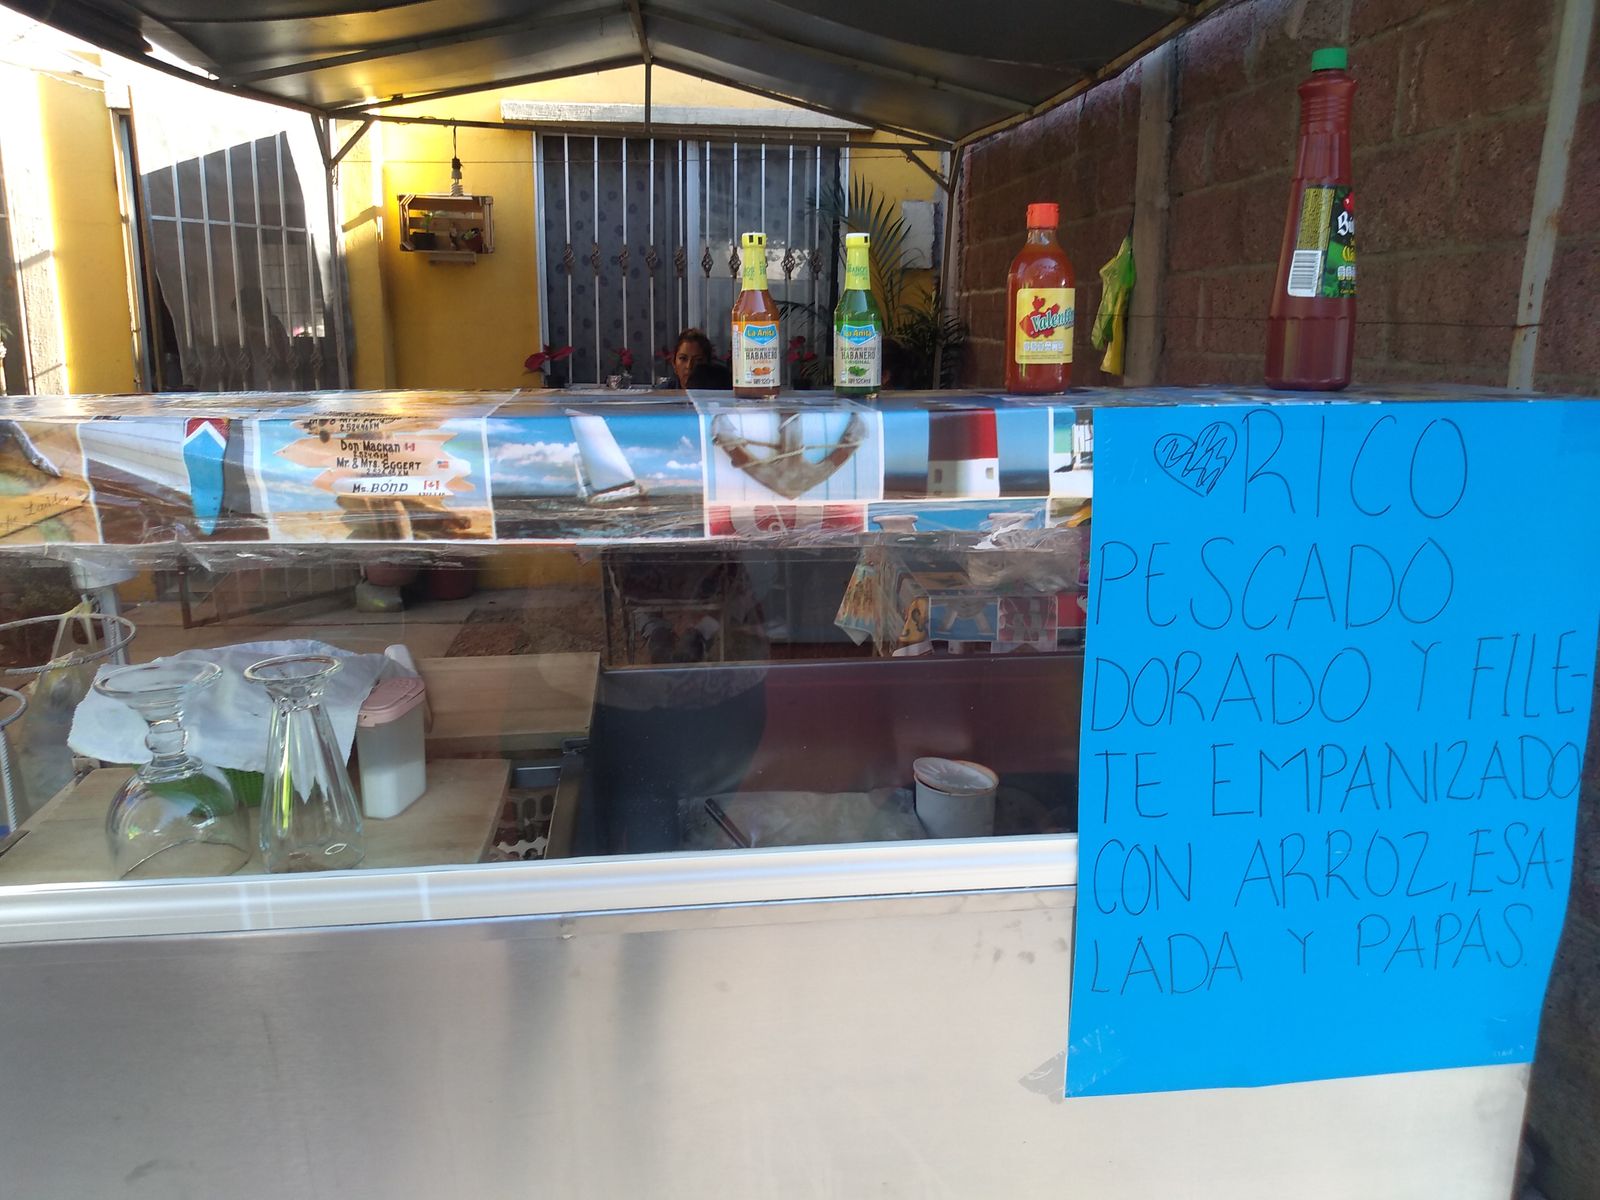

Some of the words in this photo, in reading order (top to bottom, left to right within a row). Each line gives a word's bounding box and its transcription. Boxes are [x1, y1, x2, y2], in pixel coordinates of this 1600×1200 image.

[841, 351, 876, 360] HABANERO
[336, 457, 350, 469] Mr.
[352, 458, 358, 469] &
[361, 459, 380, 469] Mrs.
[341, 440, 359, 452] Don
[1242, 408, 1468, 518] RICO
[1096, 537, 1454, 630] PESCADO
[1091, 646, 1372, 731] DORADO
[1411, 641, 1442, 711] Y
[1468, 630, 1588, 720] FILE-
[1094, 749, 1169, 824] TE
[1211, 735, 1581, 818] EMPANIZADO
[1093, 839, 1192, 916] CON
[1091, 930, 1243, 996] LADA
[1287, 928, 1314, 974] Y
